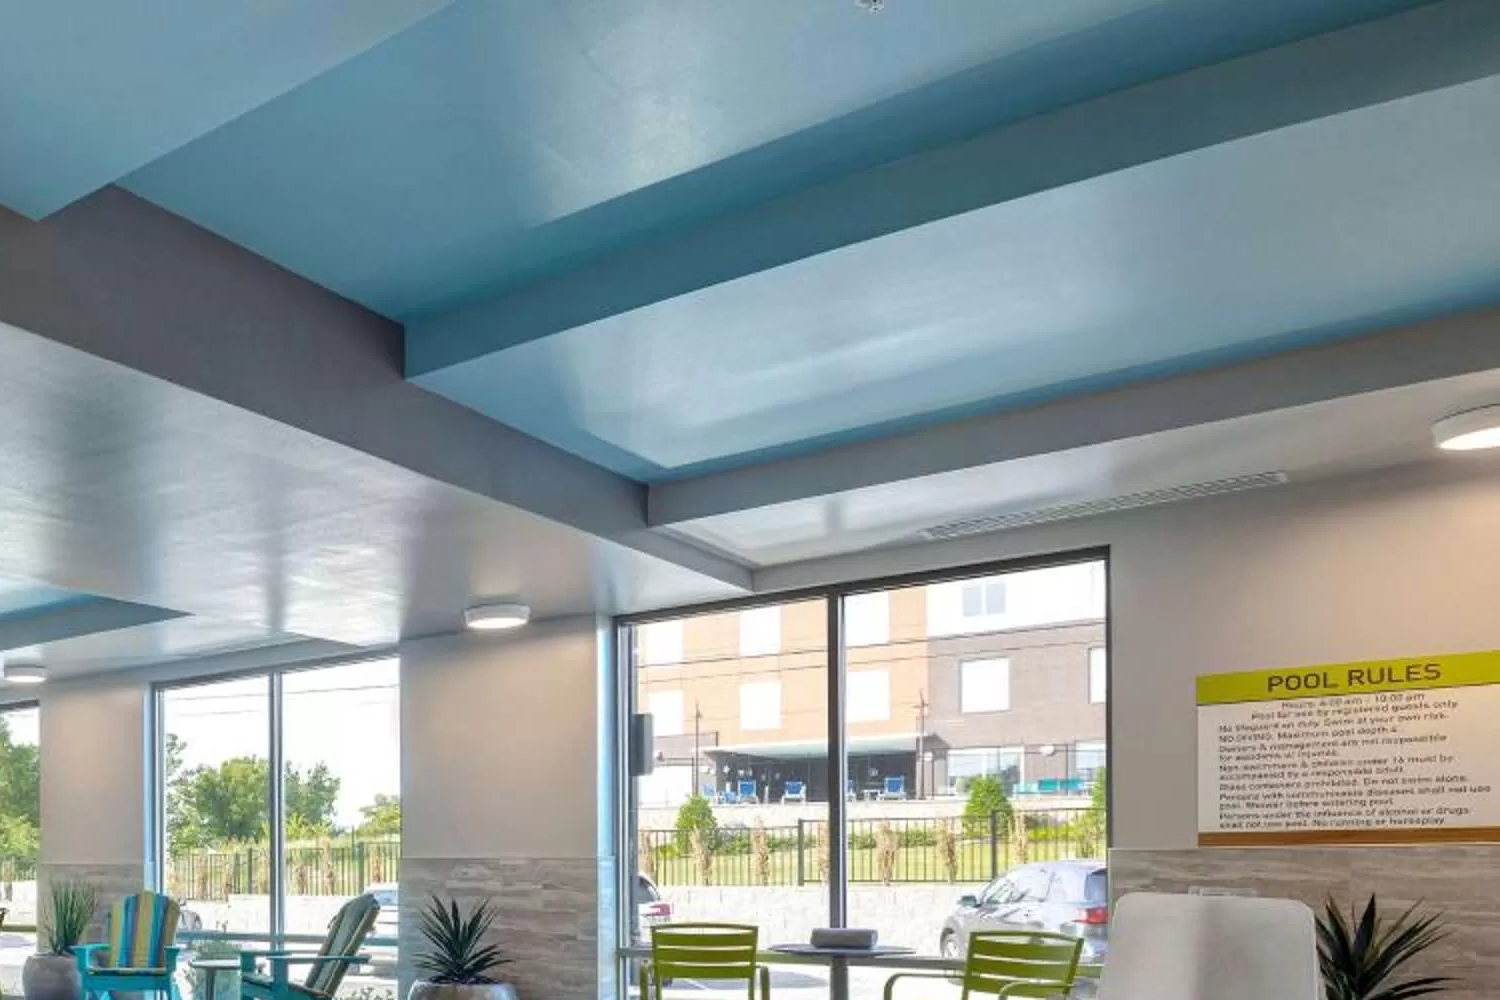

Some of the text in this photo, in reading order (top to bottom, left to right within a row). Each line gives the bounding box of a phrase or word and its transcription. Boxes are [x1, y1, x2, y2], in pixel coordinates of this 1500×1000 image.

[1267, 663, 1441, 692] POOL RULES
[1252, 711, 1274, 720] Pool
[1331, 703, 1389, 716] registered
[1391, 700, 1430, 712] guests
[1432, 699, 1458, 709] only
[1323, 717, 1354, 727] Swim
[1369, 715, 1394, 725] your
[1398, 713, 1421, 721] own
[1219, 735, 1234, 743] NO
[1277, 730, 1329, 740] Maximum
[1332, 727, 1355, 737] pool
[1357, 726, 1388, 736] depth
[1269, 739, 1338, 751] management
[1407, 753, 1437, 763] must
[1401, 775, 1433, 785] swim
[1262, 790, 1284, 800] with
[1436, 805, 1470, 816] drugs
